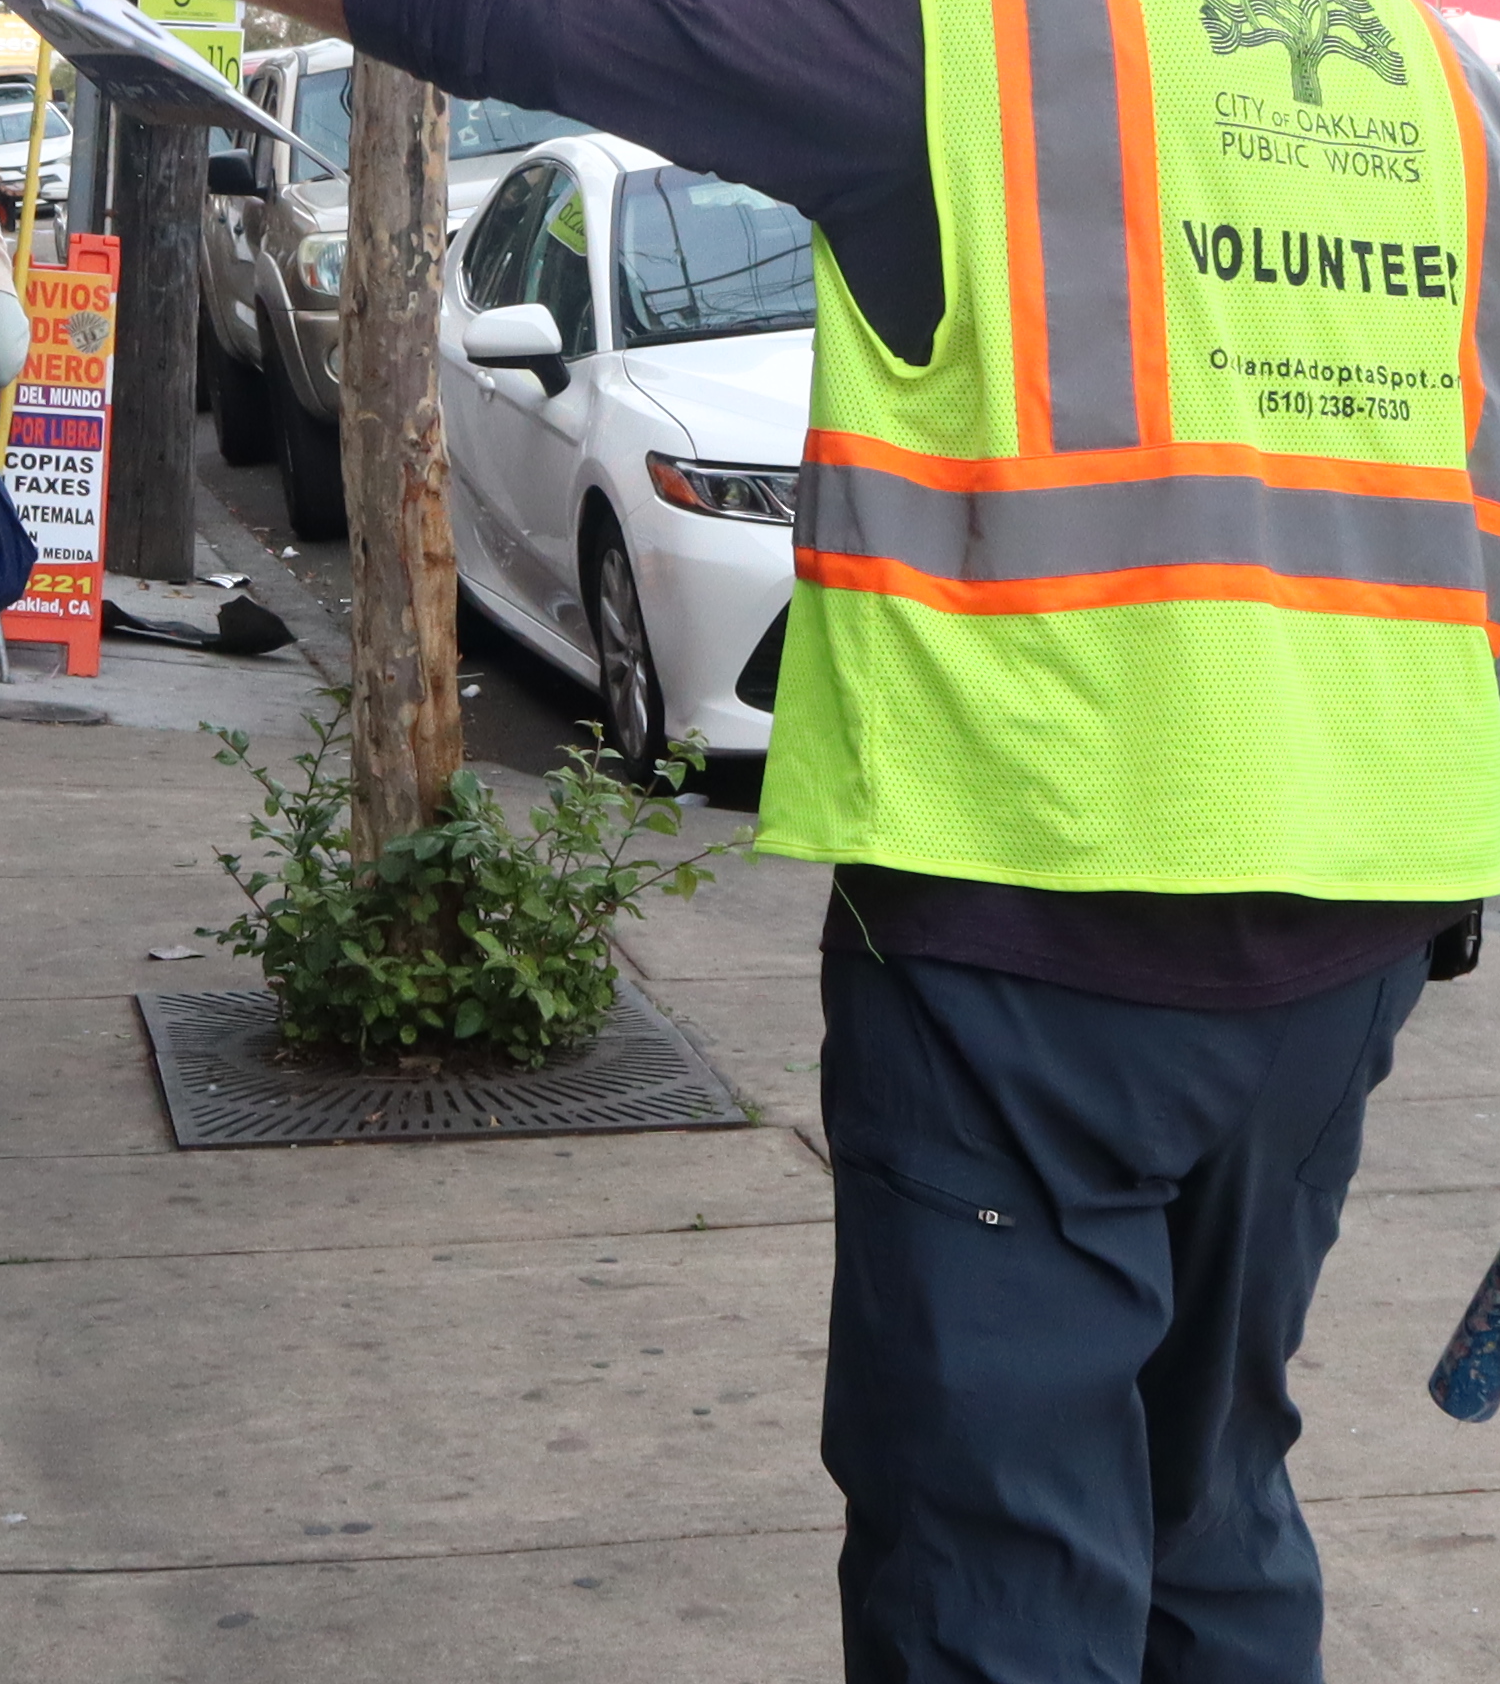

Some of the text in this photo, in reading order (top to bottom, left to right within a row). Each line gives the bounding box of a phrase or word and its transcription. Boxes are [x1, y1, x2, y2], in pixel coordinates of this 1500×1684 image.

[1214, 91, 1420, 146] CITY OF OAKLAND
[1221, 131, 1421, 183] PUBLIC WORKS
[26, 280, 111, 313] NVIOS
[31, 316, 70, 346] DE
[23, 353, 105, 385] NERO
[19, 384, 46, 403] DEL
[50, 387, 102, 409] MUNDO
[1257, 389, 1410, 422] (510) 238-7630
[10, 416, 45, 446] POR
[50, 418, 100, 448] LIBRA
[14, 475, 91, 497] FAXES
[17, 504, 95, 526] ATEMALA
[43, 547, 93, 562] MEDIDA
[25, 573, 93, 595] 221
[68, 600, 91, 616] CA
